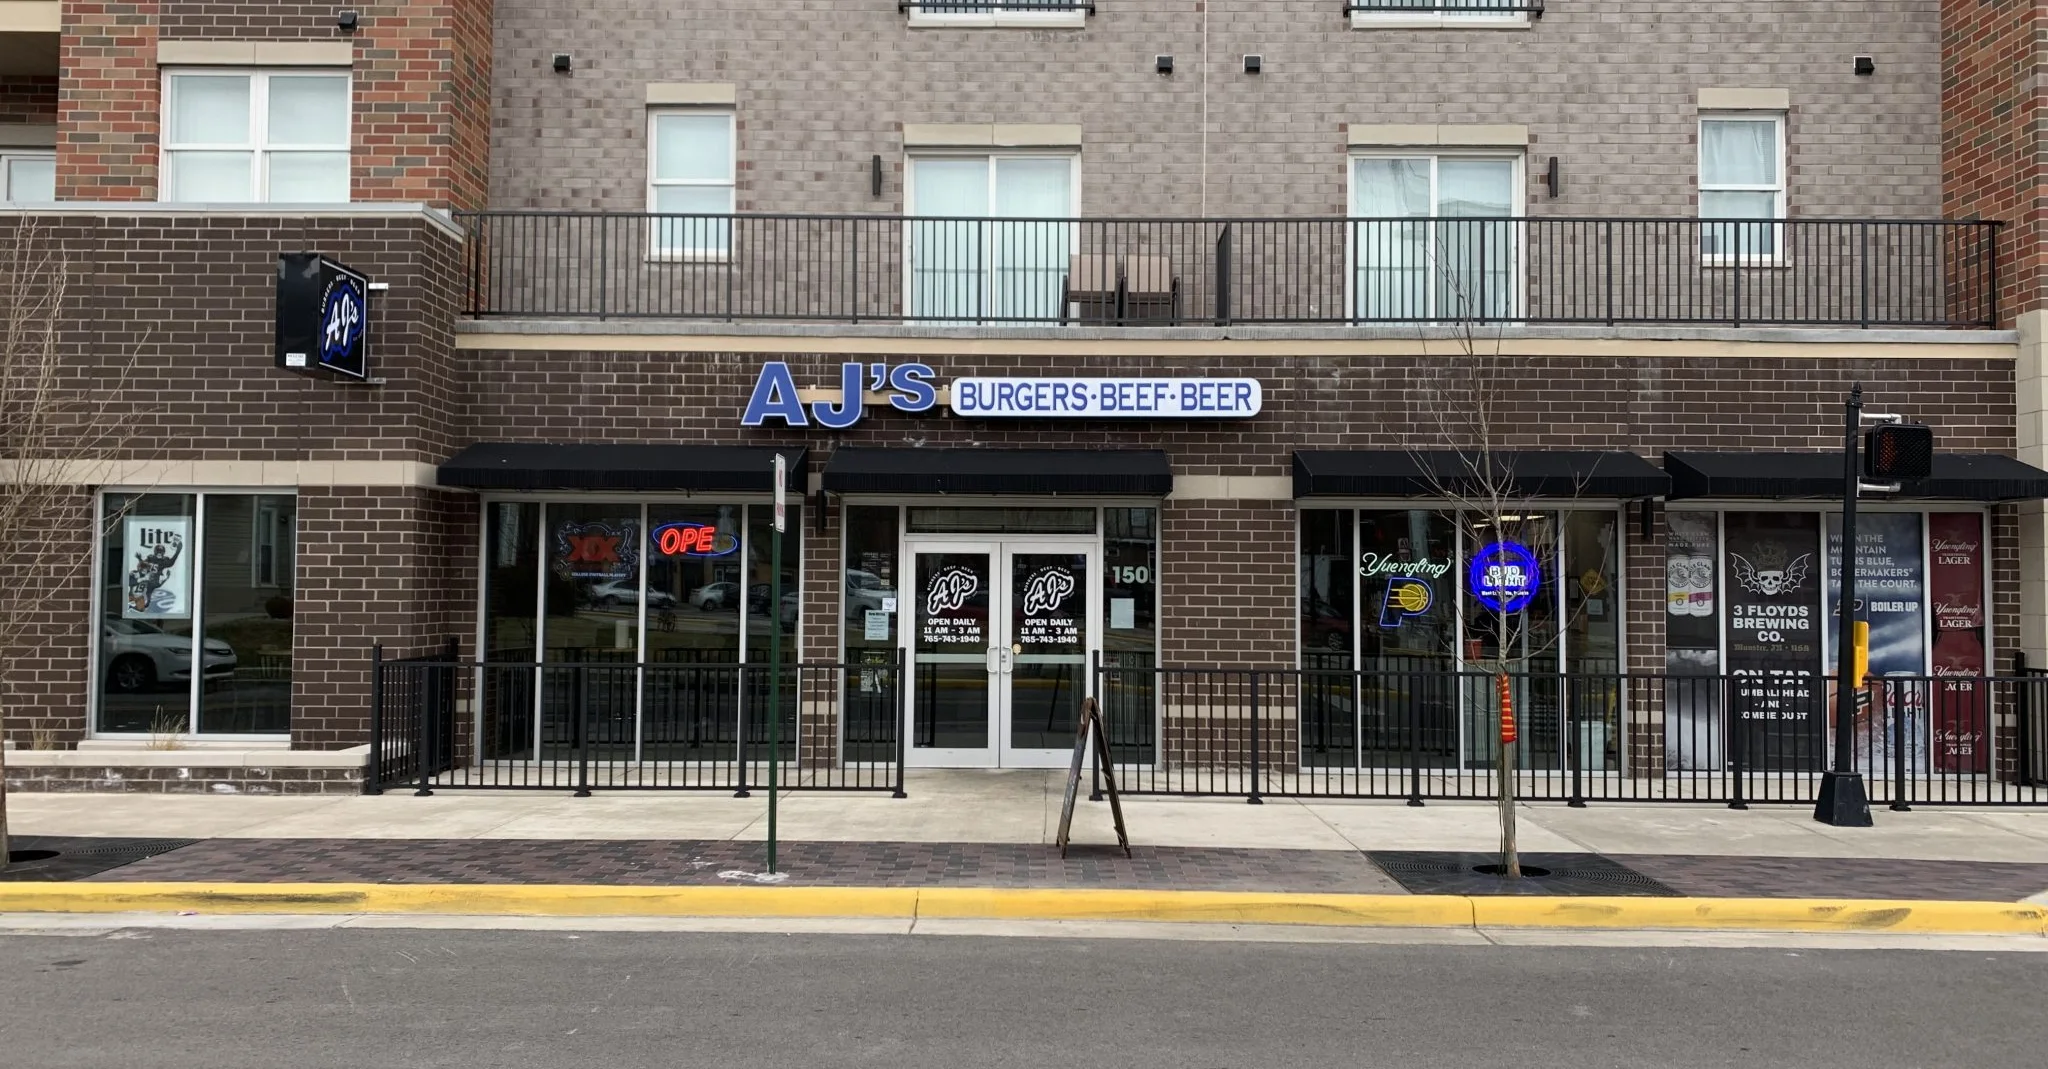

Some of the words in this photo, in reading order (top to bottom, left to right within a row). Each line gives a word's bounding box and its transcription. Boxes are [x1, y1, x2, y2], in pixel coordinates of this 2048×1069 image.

[741, 361, 937, 428] AJ'S
[959, 382, 1088, 411] BURGERS
[1099, 382, 1169, 411] BEEF
[1180, 382, 1252, 411] BEER
[140, 528, 174, 549] Lite
[1864, 534, 1884, 542] THE
[1830, 545, 1887, 554] MNTAIN
[1931, 538, 1979, 552] Yuengling
[1360, 552, 1451, 579] Yuengling
[1866, 557, 1895, 567] BLUE,
[1938, 556, 1971, 565] LAGER
[1112, 565, 1149, 584] 150
[1858, 580, 1878, 588] THE
[1880, 580, 1918, 588] COURT.
[1733, 605, 1743, 616] 3
[1747, 605, 1809, 617] FLOYDS
[1870, 601, 1904, 612] BOILER
[1905, 601, 1919, 612] UP
[1933, 601, 1980, 616] Yuengling
[1024, 618, 1047, 626] OPEN
[1050, 618, 1073, 626] DAILY
[1733, 618, 1810, 629] BREWING
[1940, 620, 1973, 628] LAGER
[923, 635, 980, 643] 765-743-1940
[1757, 630, 1785, 642] CO.
[1733, 669, 1764, 684] ON
[1769, 669, 1811, 685] TAP
